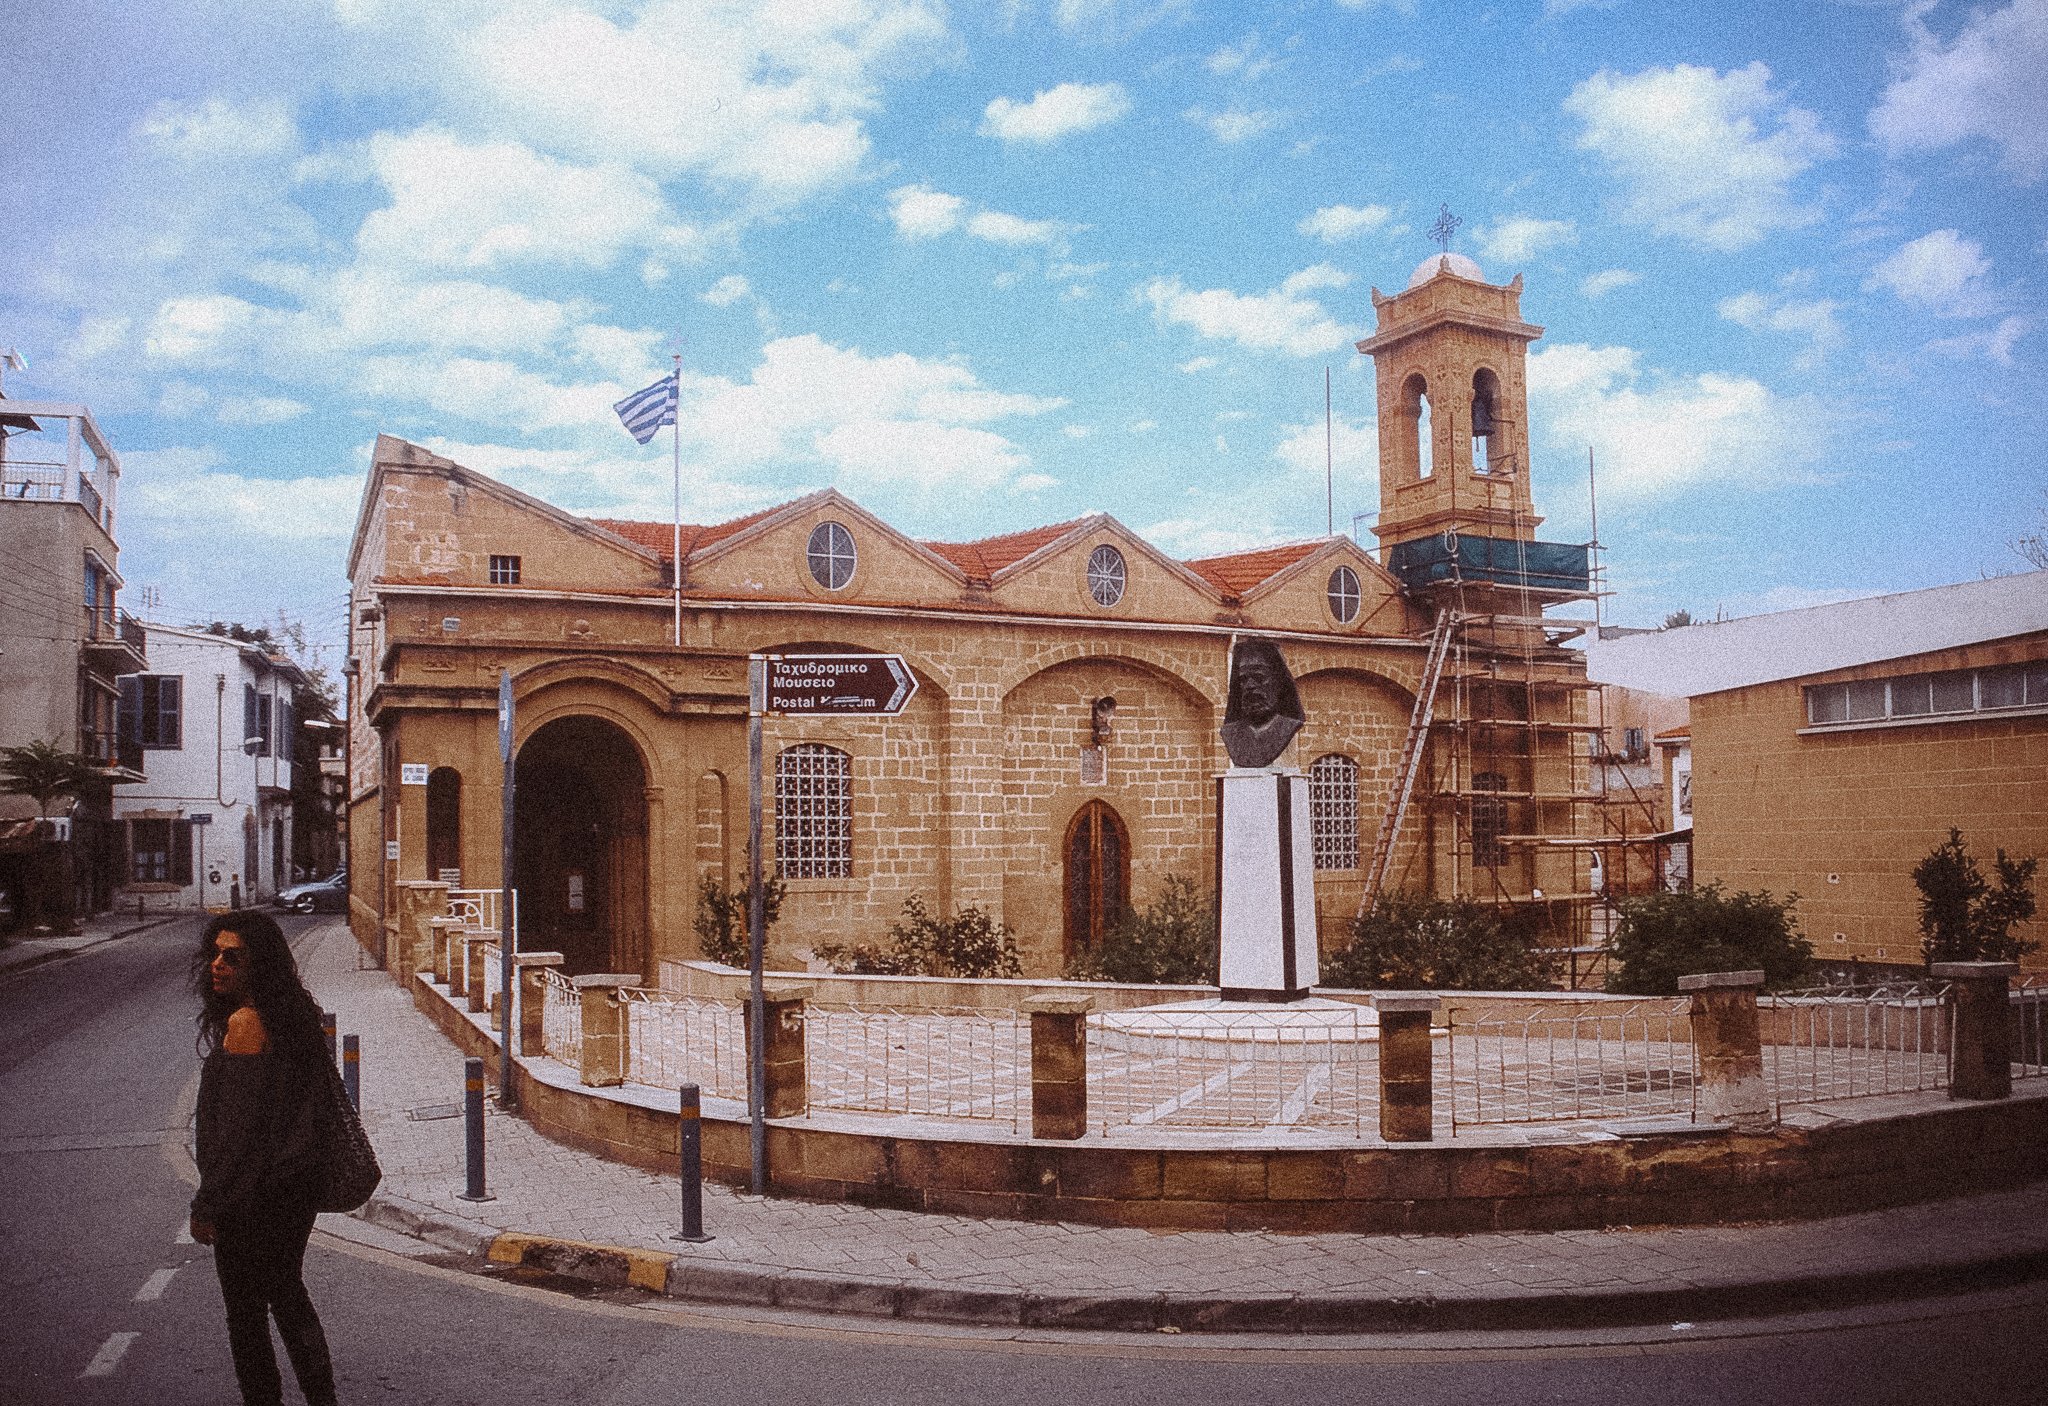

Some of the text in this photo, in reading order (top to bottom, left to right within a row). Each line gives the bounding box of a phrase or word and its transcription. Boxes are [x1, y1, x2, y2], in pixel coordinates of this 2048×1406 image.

[774, 662, 868, 675] Ταχυδρομικο
[773, 677, 835, 688] Μουσειο
[773, 696, 815, 708] Postal
